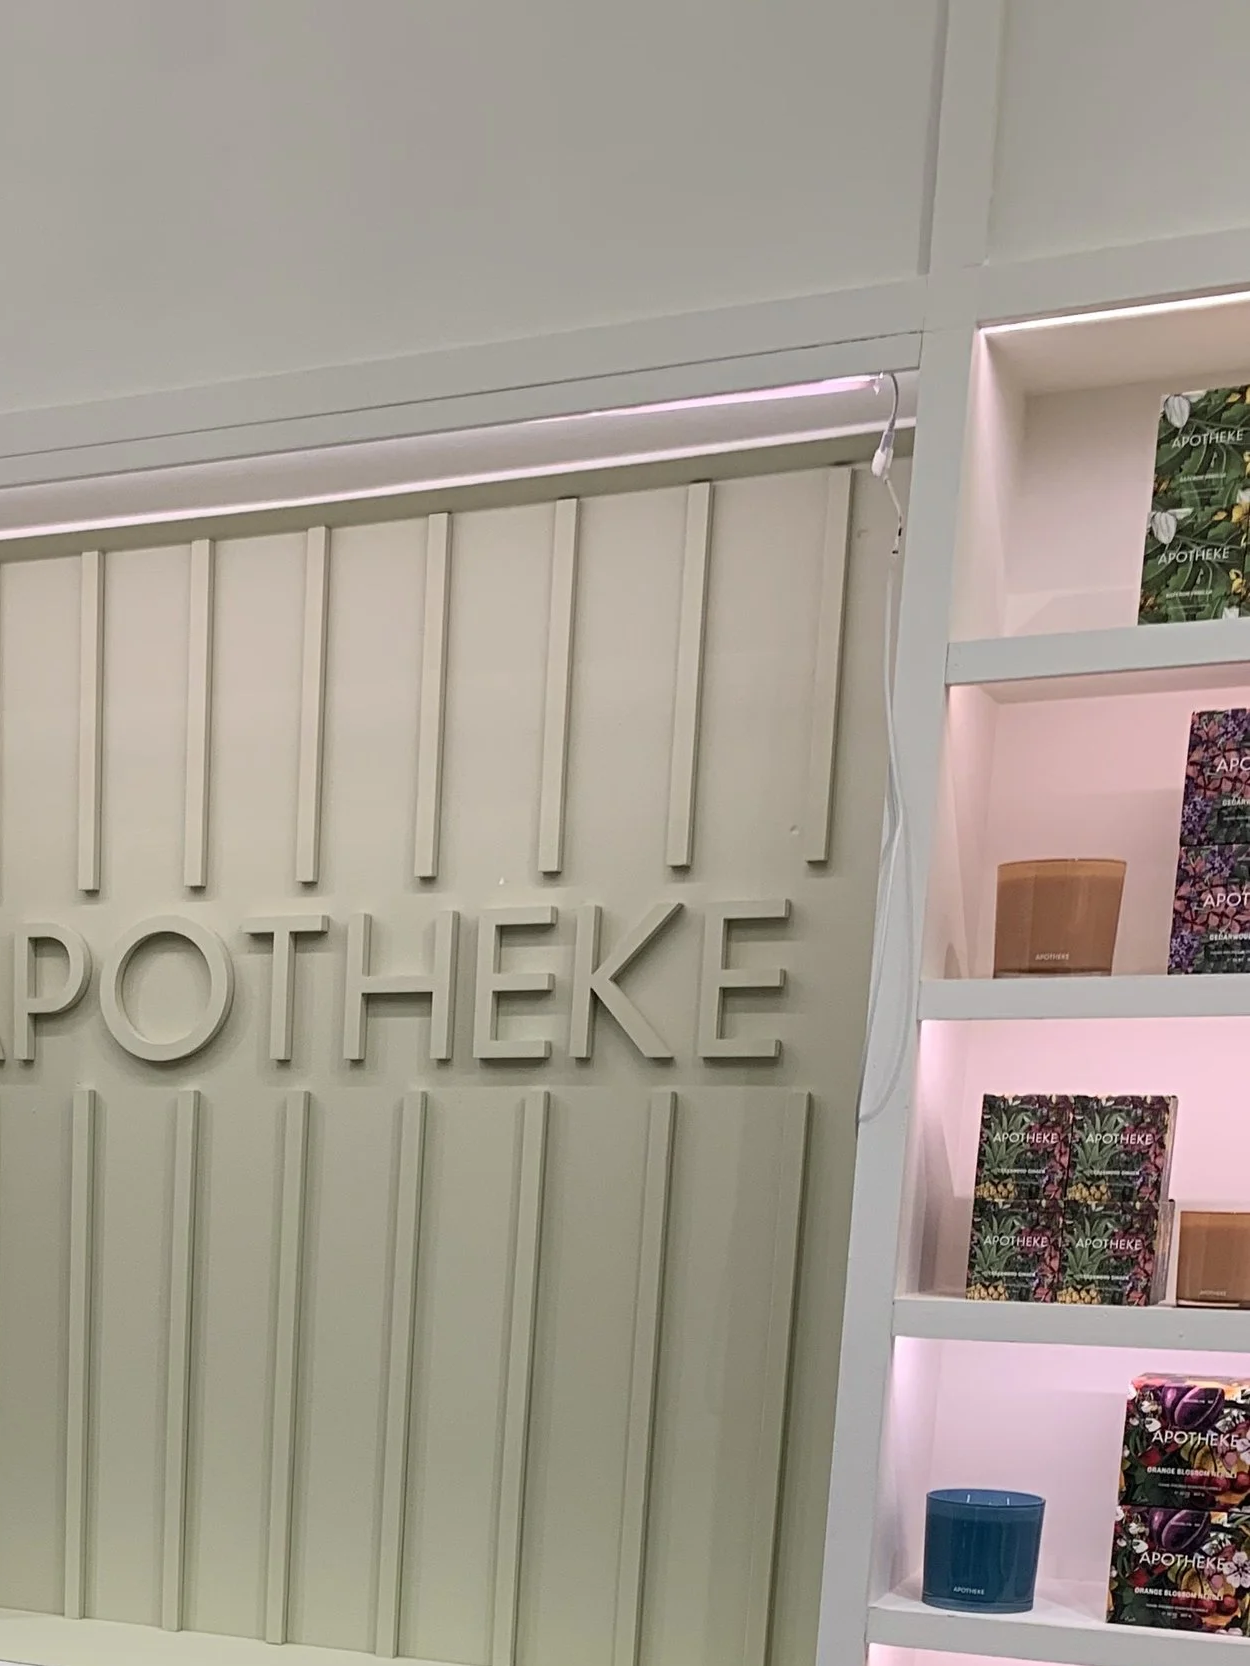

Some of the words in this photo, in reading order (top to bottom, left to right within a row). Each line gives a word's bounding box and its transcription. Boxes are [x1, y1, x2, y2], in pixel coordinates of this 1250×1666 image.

[1171, 430, 1244, 449] APOTHEKE
[1157, 547, 1230, 565] APOTHEKE
[993, 1132, 1058, 1144] APOTHEKE
[1086, 1133, 1154, 1146] APOTHEKE
[983, 1235, 1048, 1248] APOTHEKE
[1076, 1238, 1143, 1251] APOTHEKE
[1151, 1429, 1240, 1449] APOTHEKE
[1147, 1466, 1175, 1476] ORANGE
[1177, 1468, 1210, 1479] BLOSSOM
[1139, 1550, 1227, 1571] APOTHEKE
[953, 1586, 985, 1595] APOTHEKE
[1134, 1586, 1163, 1596] ORANGE
[1164, 1588, 1197, 1600] BLOSSOM
